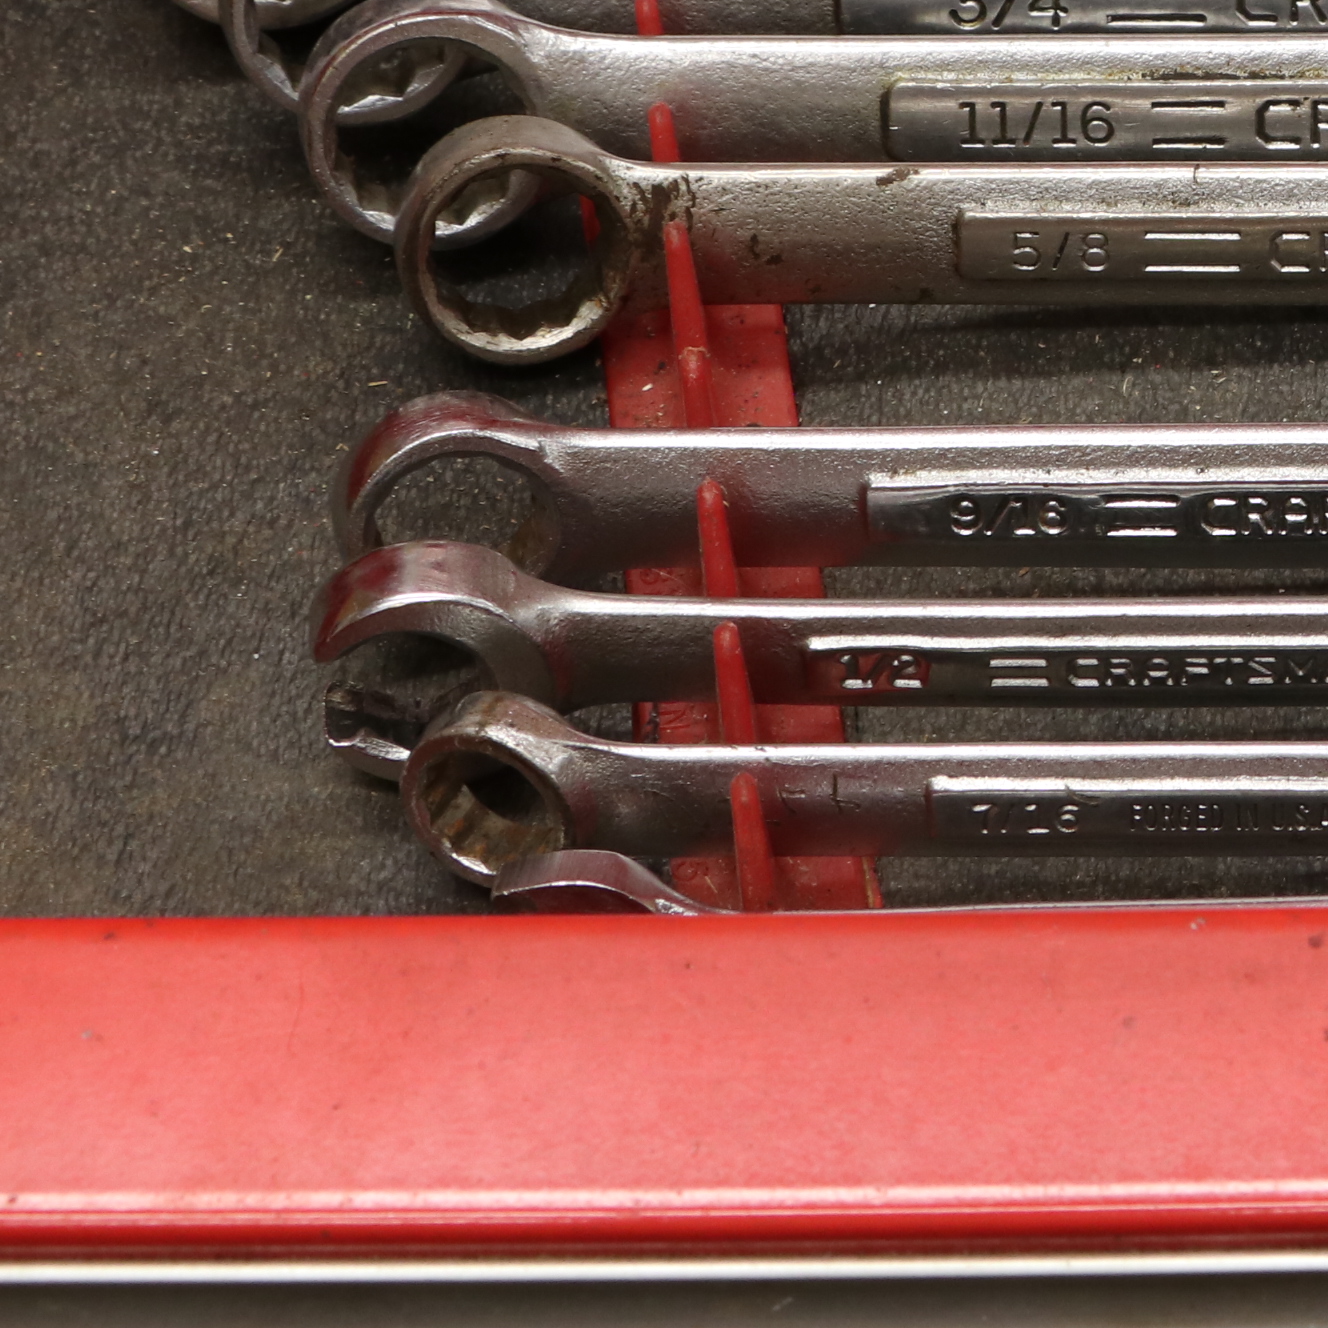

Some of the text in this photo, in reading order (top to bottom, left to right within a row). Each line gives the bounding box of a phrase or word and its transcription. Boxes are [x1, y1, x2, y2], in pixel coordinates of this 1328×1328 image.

[958, 100, 1117, 149] 11/16
[1012, 232, 1112, 272] 5/8
[950, 497, 1068, 536] 9/16
[840, 653, 923, 690] 1/2
[971, 801, 1083, 835] 7/16
[1129, 802, 1224, 832] FORGED
[1236, 802, 1260, 832] IN
